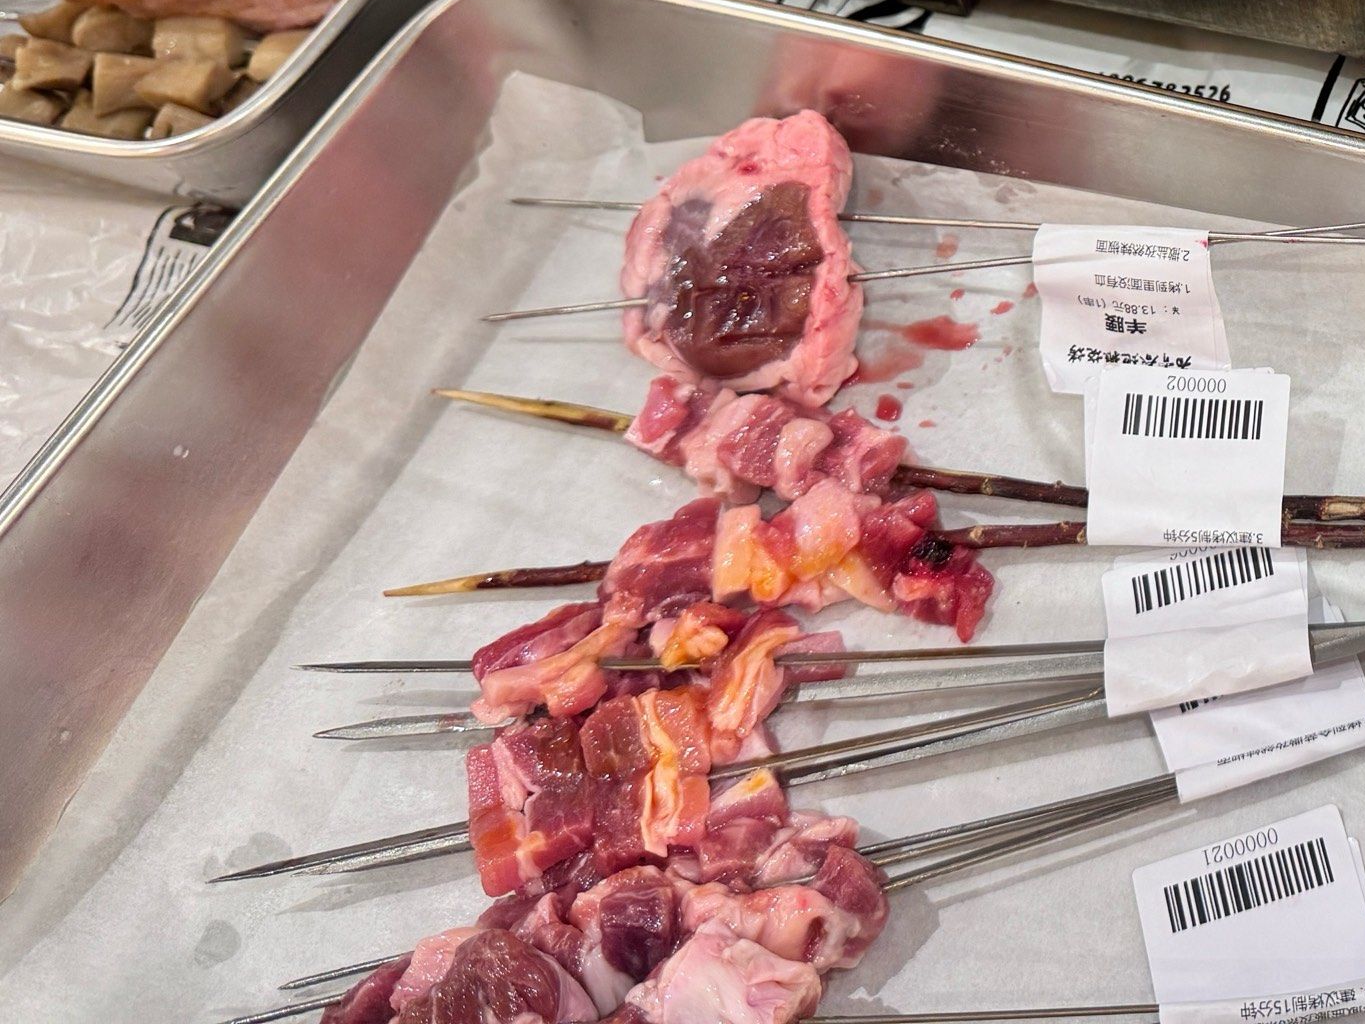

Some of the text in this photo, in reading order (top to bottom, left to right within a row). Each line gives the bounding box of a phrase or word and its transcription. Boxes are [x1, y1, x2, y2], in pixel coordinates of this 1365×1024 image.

[1095, 238, 1190, 263] 2.撒盐孜然辣椒面
[1094, 273, 1191, 294] 1.烤到里面没有血
[1103, 313, 1147, 335] 羊腰
[1166, 375, 1227, 394] 000002
[1163, 528, 1264, 544] 3.建议烤制5分钟
[1200, 825, 1279, 866] 0000021
